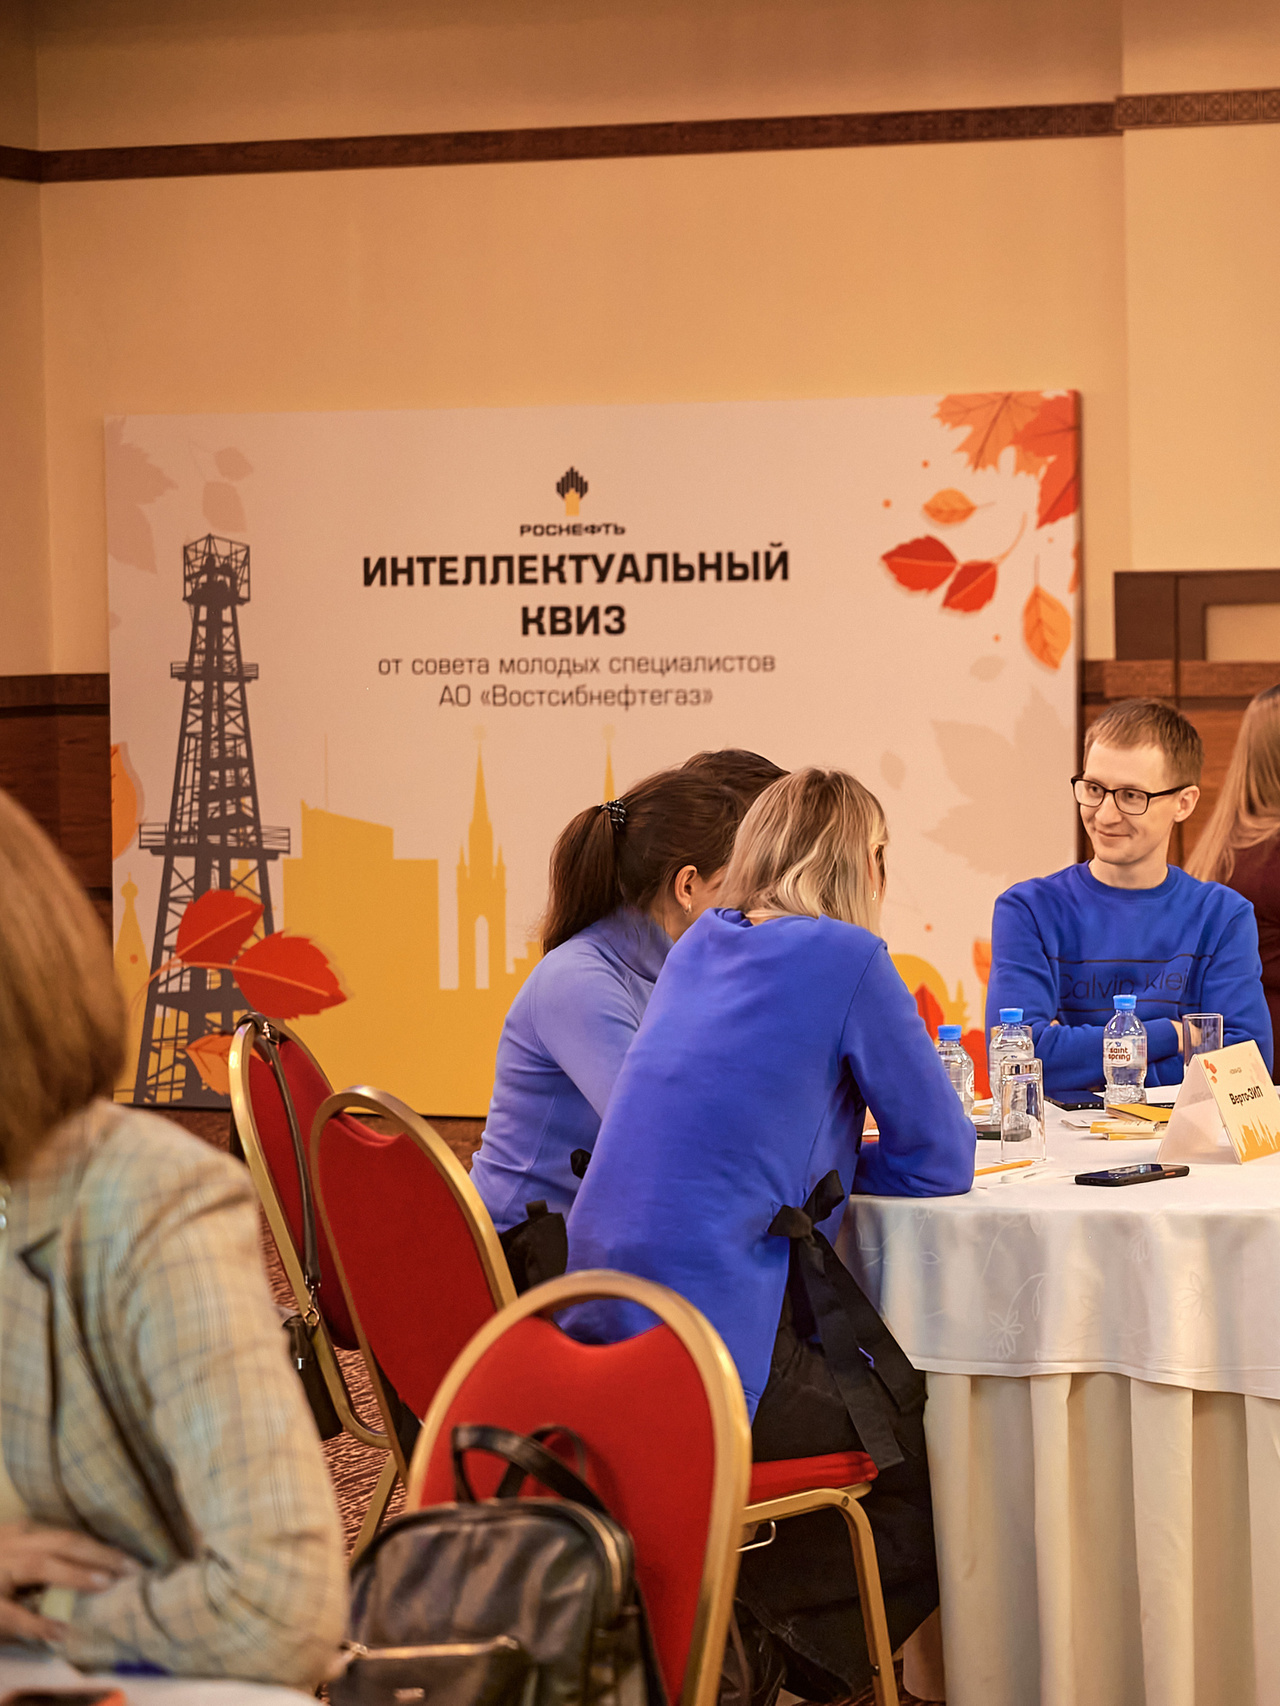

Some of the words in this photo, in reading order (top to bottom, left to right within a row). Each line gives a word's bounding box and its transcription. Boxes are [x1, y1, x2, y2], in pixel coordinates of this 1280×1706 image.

[519, 523, 626, 537] РОСНЕФТЬ
[363, 542, 789, 587] ИНТЕЛЛЕКТУАЛЬНЫЙ
[521, 605, 626, 636] КВИЗ
[378, 658, 402, 675] от
[411, 657, 490, 675] совета
[499, 656, 600, 678] молодых
[609, 655, 776, 677] специалистов
[439, 684, 471, 707] АО
[480, 683, 713, 711] «Востсибнефтегаз»
[1059, 972, 1135, 999] Calvin
[1144, 968, 1188, 992] Klei
[1108, 1053, 1131, 1061] spring
